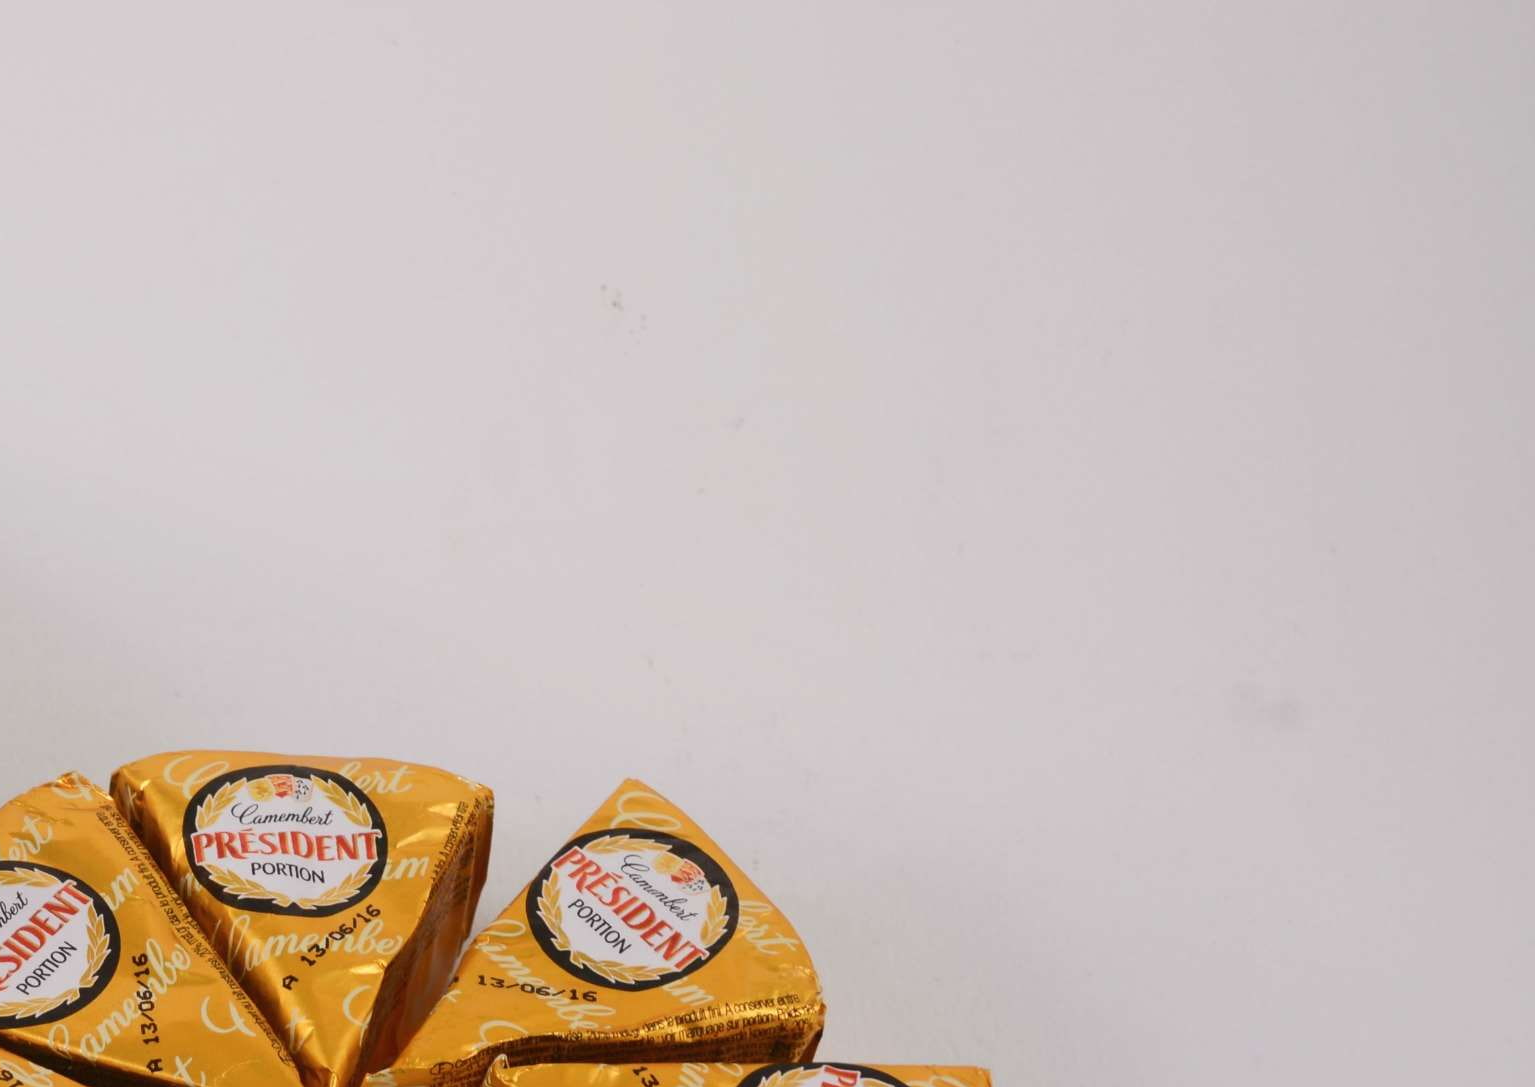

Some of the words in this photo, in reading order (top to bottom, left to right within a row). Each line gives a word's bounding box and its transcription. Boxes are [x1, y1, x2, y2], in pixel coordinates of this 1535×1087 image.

[230, 802, 334, 826] Camembert
[192, 829, 382, 863] PRÉSIDENT
[250, 861, 326, 884] PORTION
[552, 846, 708, 971] PRÉSIDENT
[620, 853, 701, 923] Camembert
[301, 904, 382, 967] 13/06/16
[566, 897, 632, 955] PORTION
[15, 940, 78, 996] PORTION
[476, 974, 599, 1004] 13/06/16
[134, 951, 161, 1048] 13/06/16
[146, 1057, 163, 1074] A
